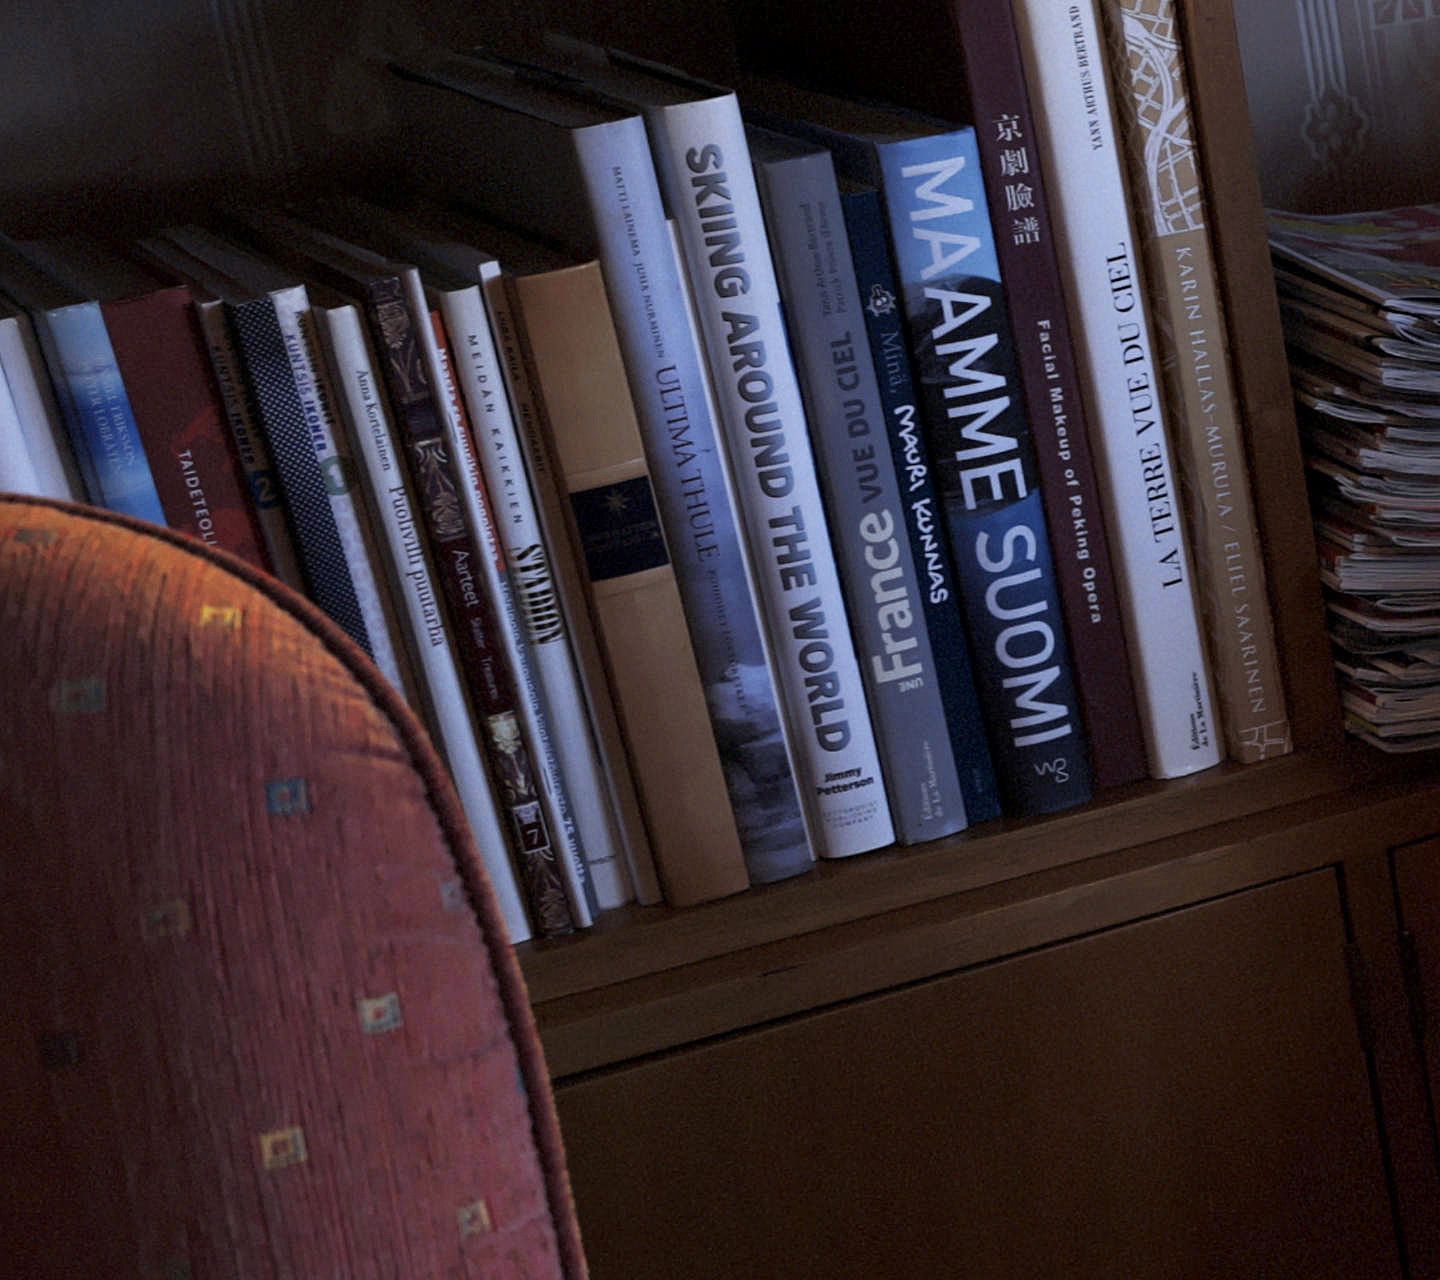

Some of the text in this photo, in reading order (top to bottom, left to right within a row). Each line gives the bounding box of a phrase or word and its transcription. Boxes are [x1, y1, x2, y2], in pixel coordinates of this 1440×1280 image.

[610, 165, 628, 201] MATTI
[1085, 119, 1100, 150] YANN
[283, 332, 328, 452] KUNTSIS IKONER
[464, 333, 525, 524] MEIDÄN KAIKKIEN
[650, 365, 699, 466] ULTIMA
[681, 469, 726, 560] THULE
[686, 143, 850, 755] SKIING AROUND THE WORLD
[900, 156, 1075, 749] MAAMME SUOMI
[1038, 318, 1104, 624] Facial Makeup of Peking Opera
[1107, 242, 1182, 588] LA TERRE VUE DU CIEL
[1172, 246, 1271, 713] KARIN HALLAS-MURULA ELIEL SAARINEN
[355, 368, 449, 647] Anna Kortelainen Puolivilli puutarha
[450, 547, 480, 608] Aarteet
[512, 543, 563, 647] STADION
[835, 329, 924, 688] France VUE DU CIEL
[894, 403, 948, 606] MAURI KUNNAS
